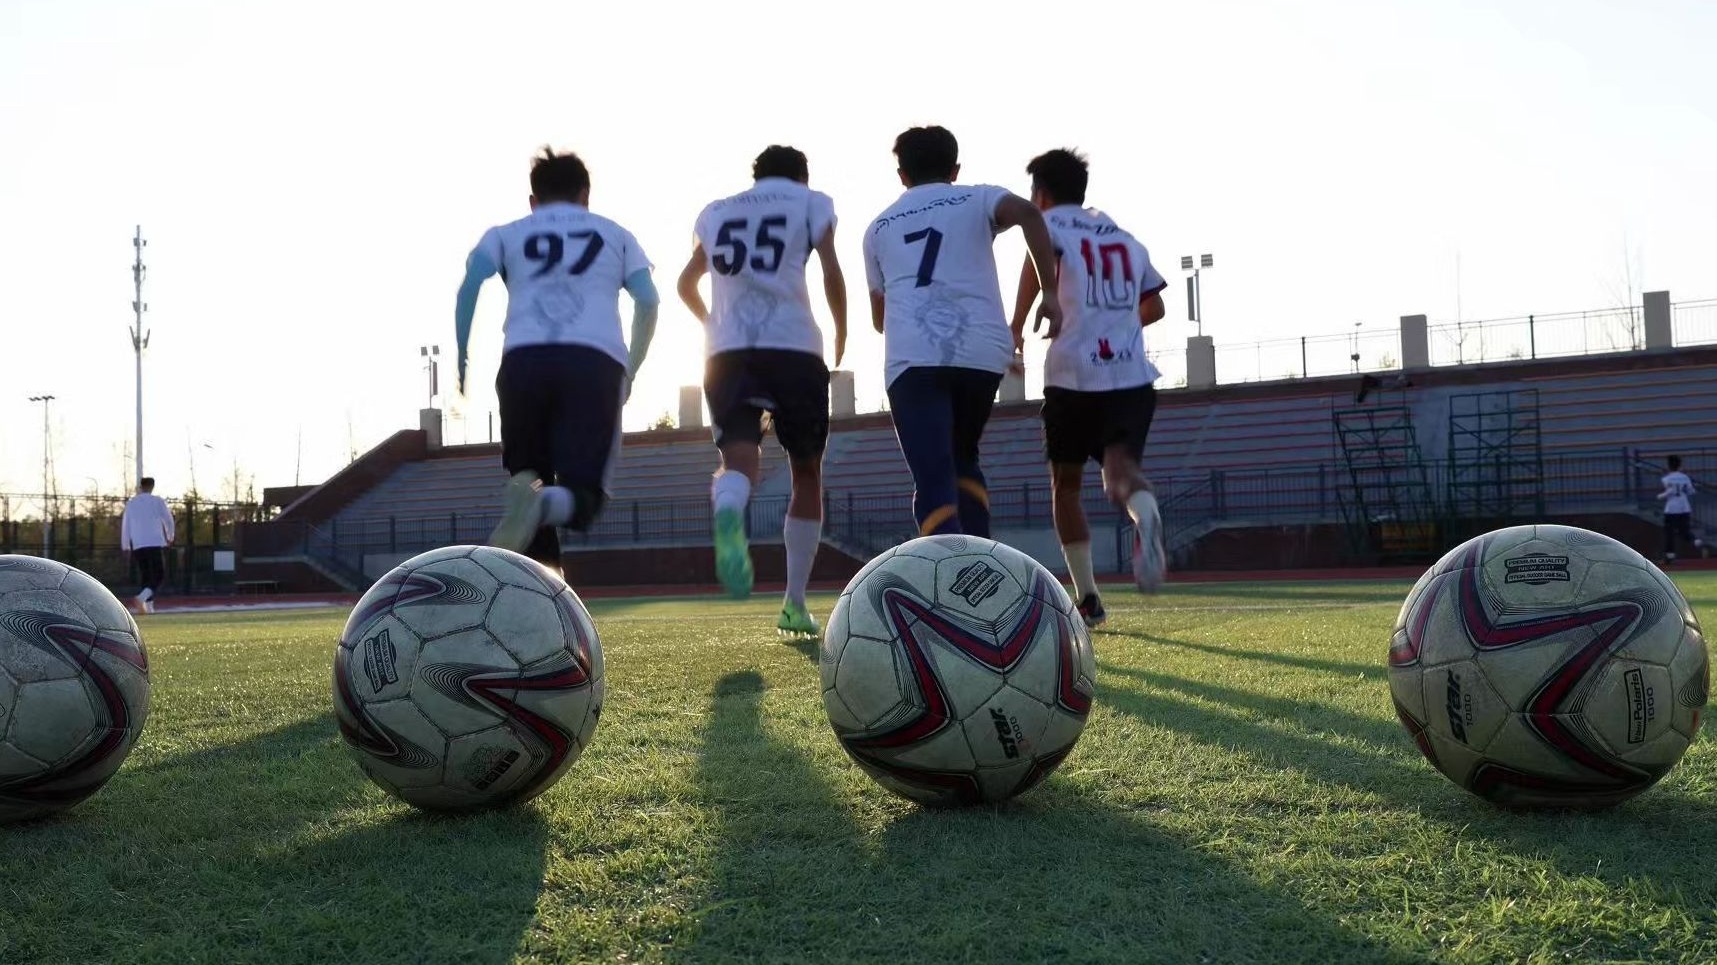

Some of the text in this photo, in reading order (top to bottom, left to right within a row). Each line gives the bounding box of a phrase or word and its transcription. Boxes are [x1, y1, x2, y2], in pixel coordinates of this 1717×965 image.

[523, 228, 605, 279] 97
[712, 214, 787, 276] 55
[903, 226, 944, 288] 7
[1080, 236, 1137, 312] 10
[1464, 694, 1473, 726] 1000
[1631, 673, 1643, 721] Polaris
[1646, 687, 1655, 722] 1000
